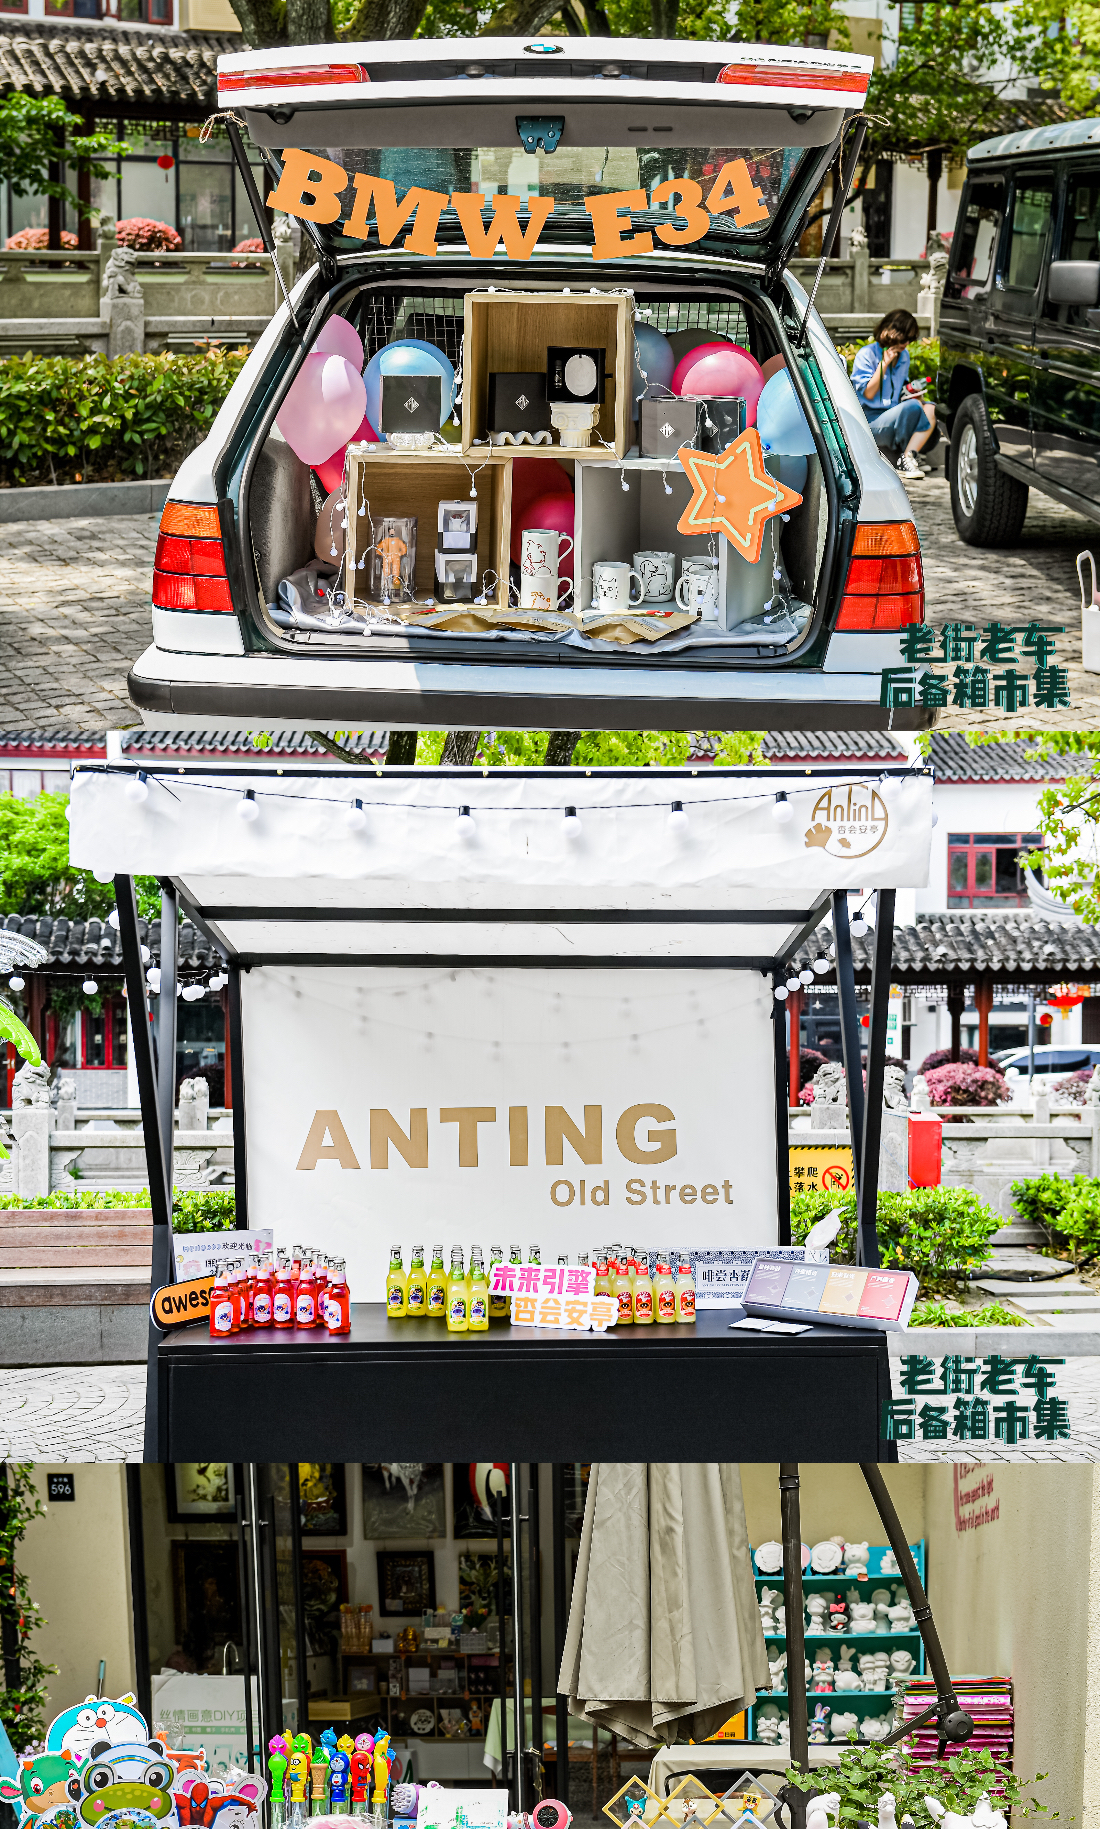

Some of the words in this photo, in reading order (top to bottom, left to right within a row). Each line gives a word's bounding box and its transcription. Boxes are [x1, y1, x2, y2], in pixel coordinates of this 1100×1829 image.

[266, 148, 554, 260] BMW
[585, 158, 771, 260] E34
[296, 1103, 679, 1171] ANTING
[550, 1178, 612, 1207] Old
[624, 1178, 735, 1207] Street
[493, 1266, 592, 1295] 未来引擎
[515, 1296, 613, 1327] 杏会安亭
[51, 1484, 71, 1494] 596
